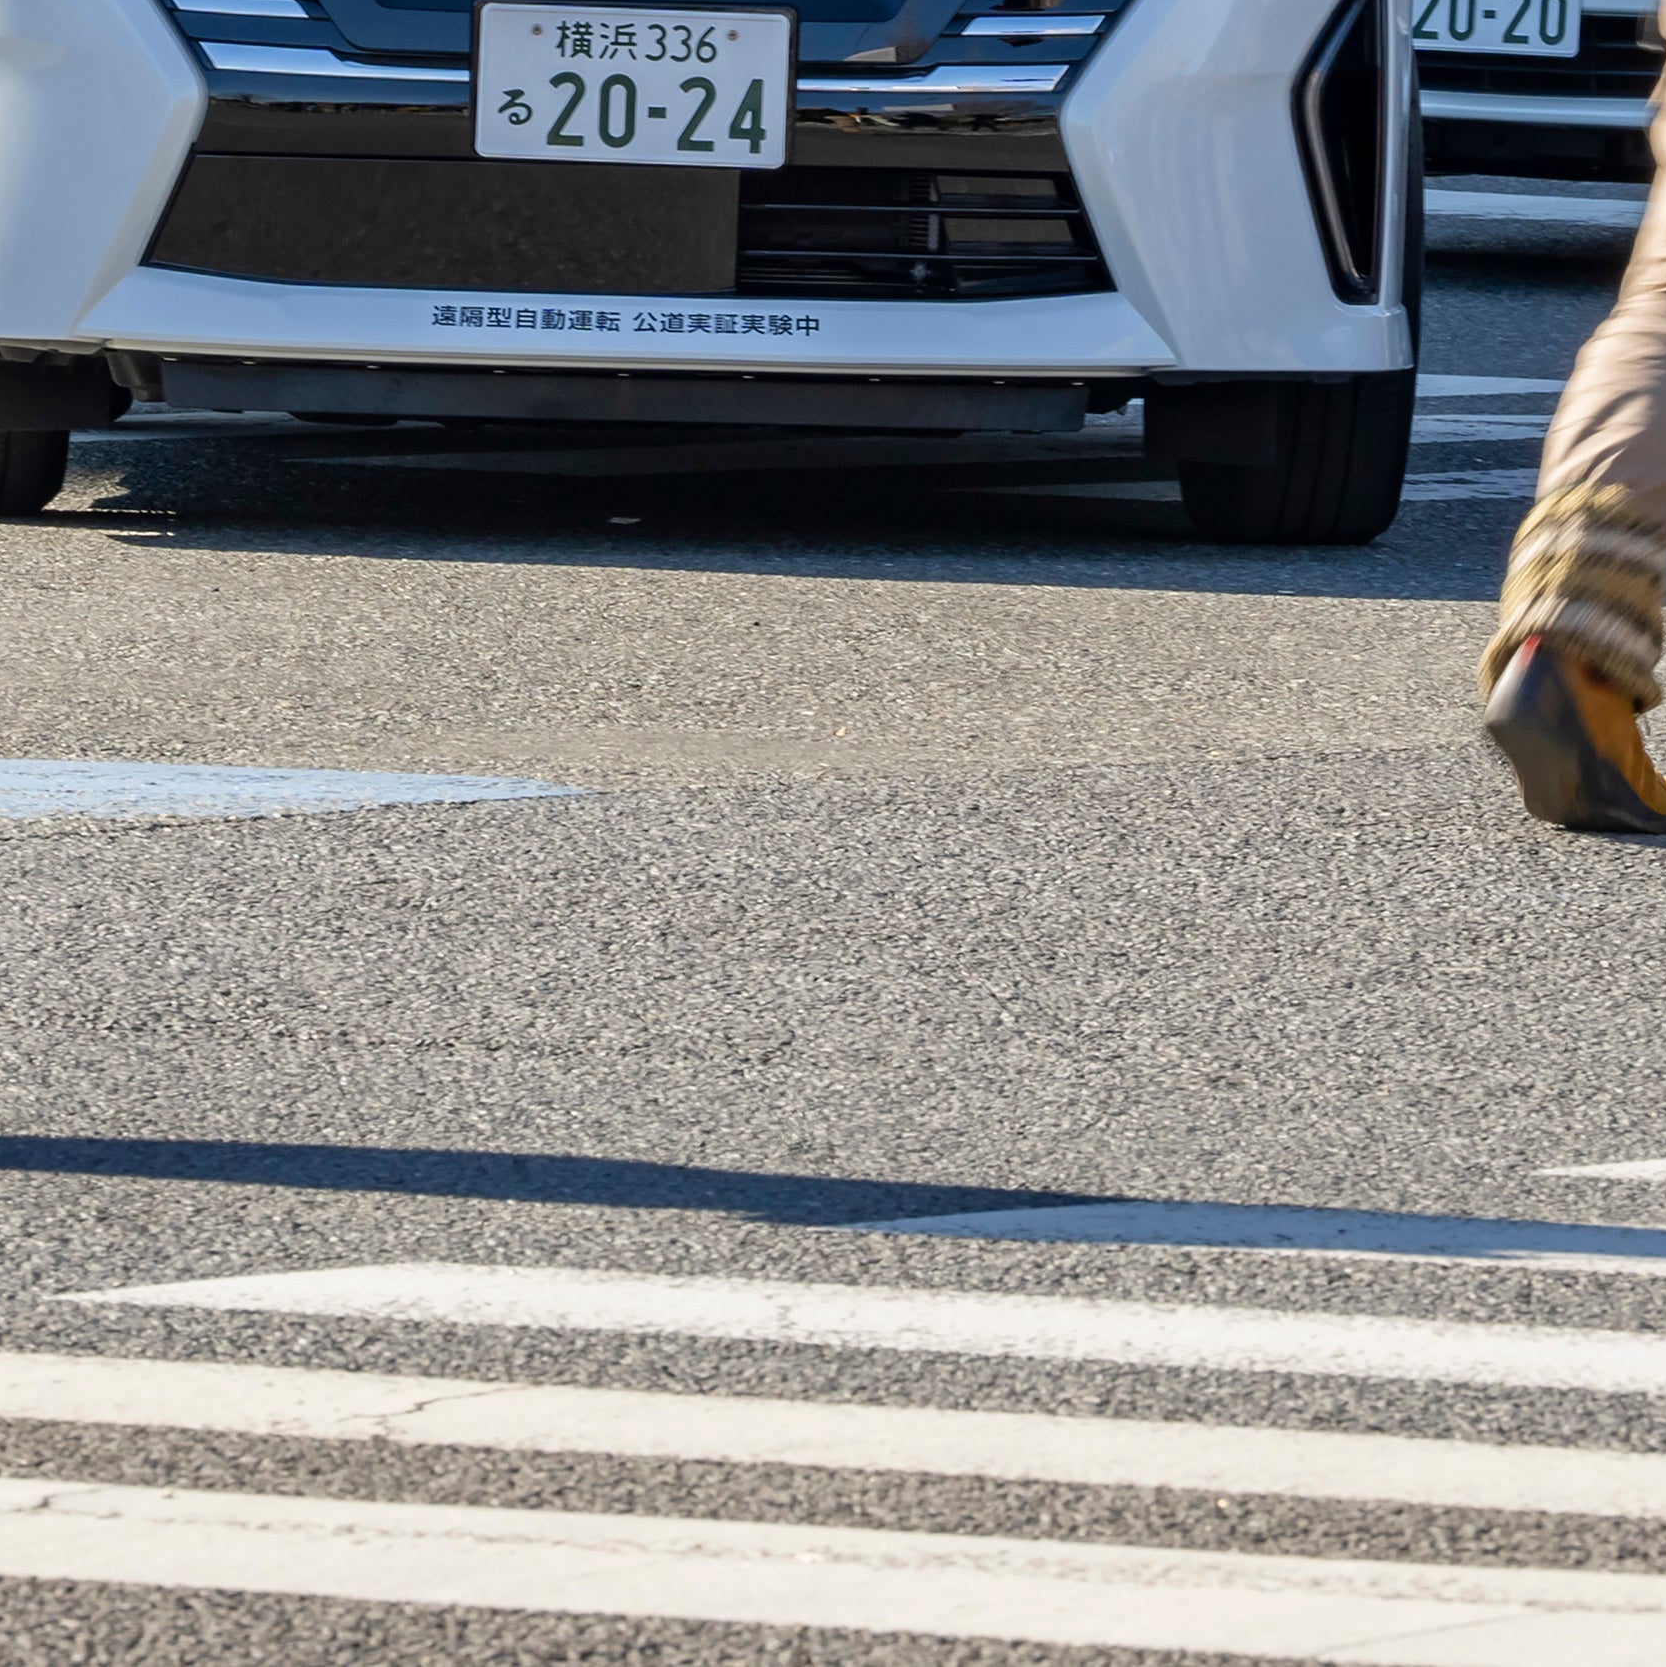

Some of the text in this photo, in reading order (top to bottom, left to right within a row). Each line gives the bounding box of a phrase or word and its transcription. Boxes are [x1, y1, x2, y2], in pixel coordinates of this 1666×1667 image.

[498, 71, 767, 154] る 20-24
[432, 305, 821, 337] 遠隔型自動運転 公道実証実験中
